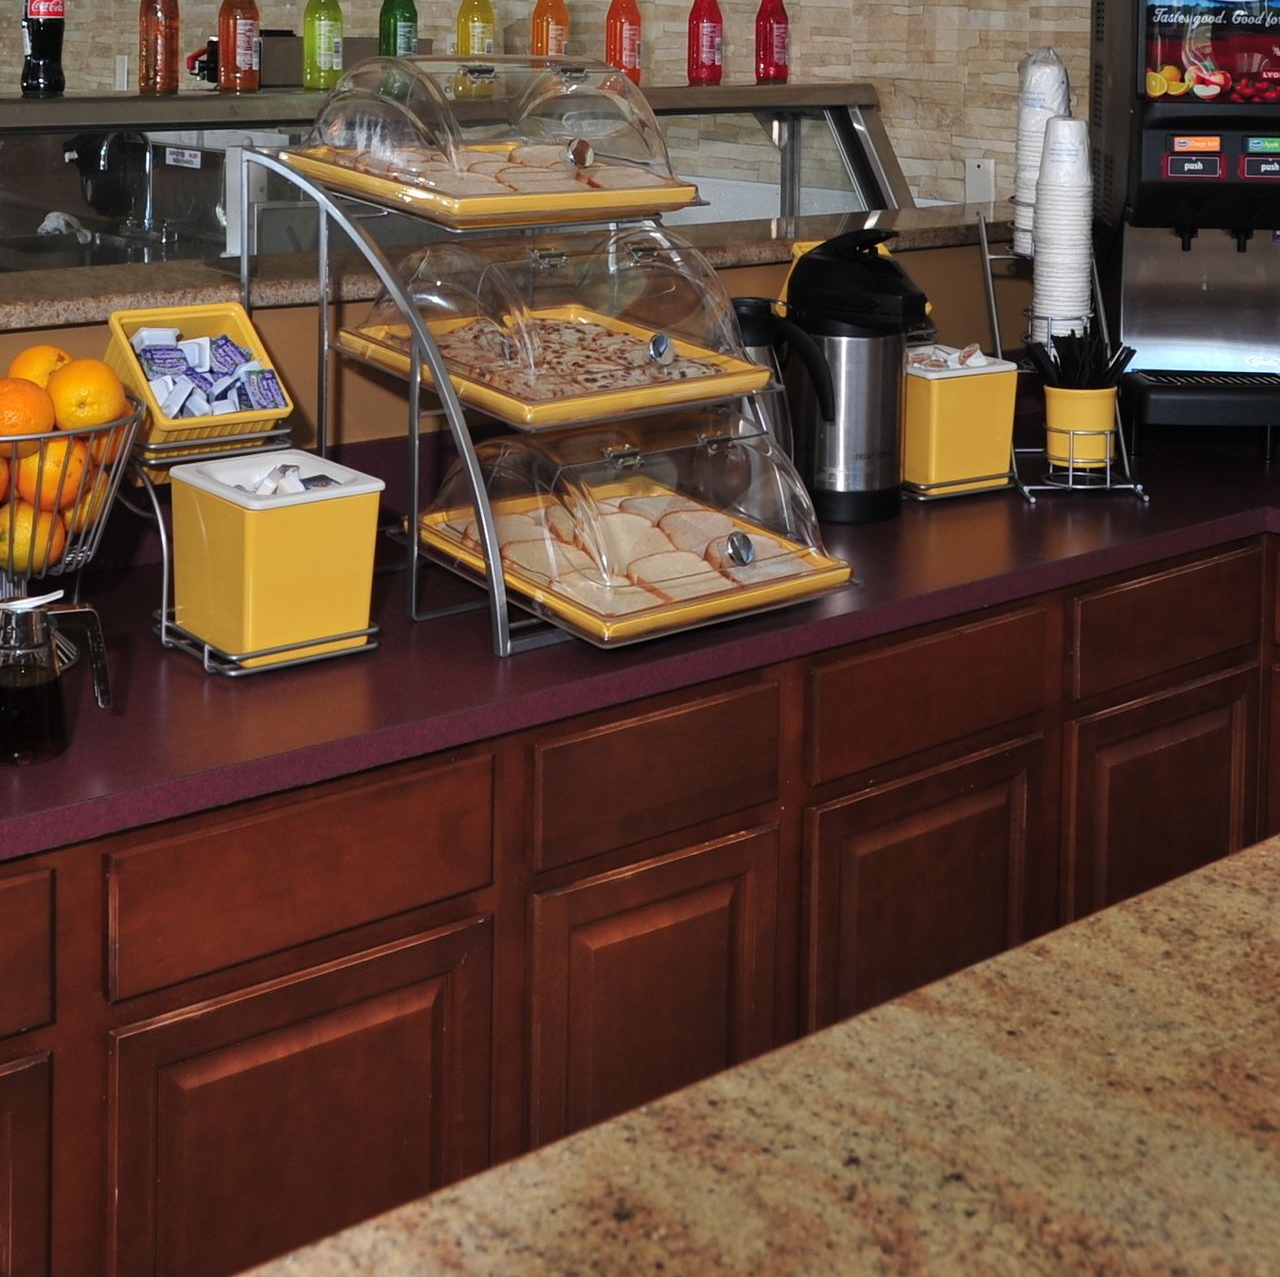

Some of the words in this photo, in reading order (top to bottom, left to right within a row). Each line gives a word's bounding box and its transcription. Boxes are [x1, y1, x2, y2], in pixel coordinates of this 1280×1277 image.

[1152, 8, 1189, 23] Tastes
[1232, 10, 1263, 25] Good
[1184, 161, 1203, 172] push
[1261, 162, 1280, 173] push
